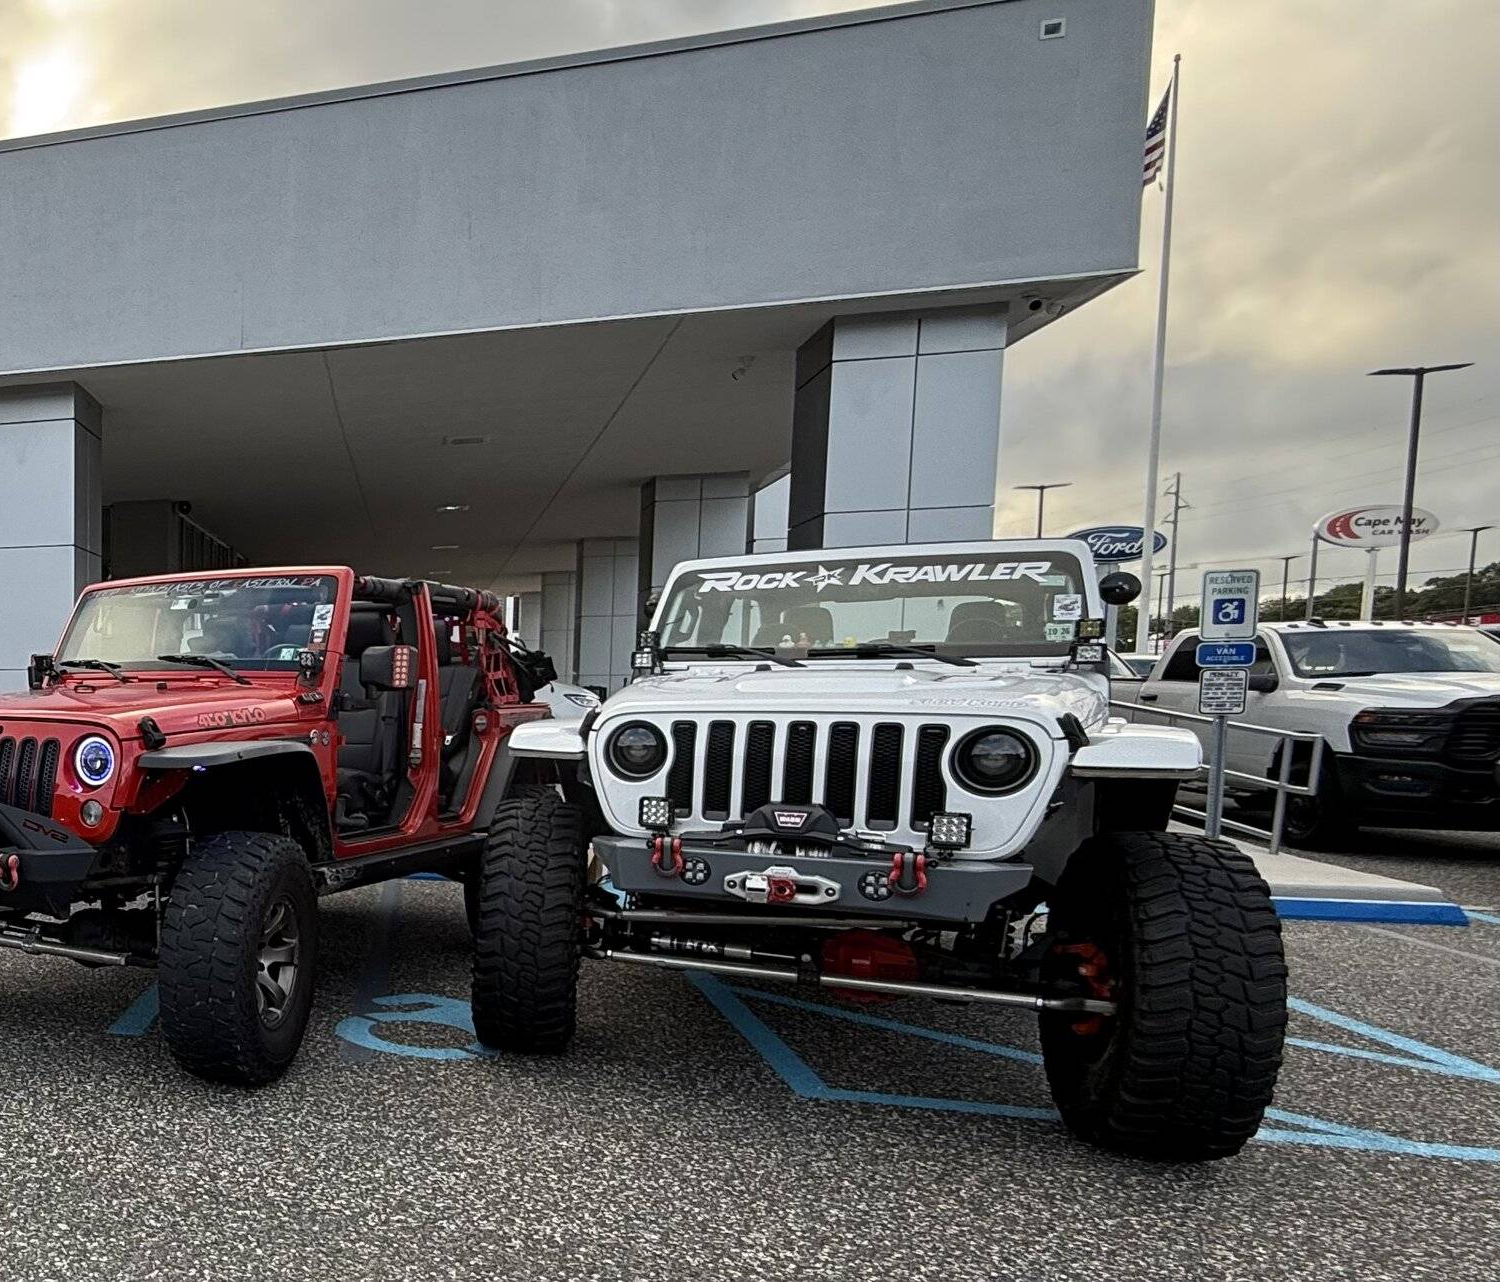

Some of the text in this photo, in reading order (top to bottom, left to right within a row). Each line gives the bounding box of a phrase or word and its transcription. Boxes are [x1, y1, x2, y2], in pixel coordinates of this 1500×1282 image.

[1355, 516, 1427, 528] Cape May
[1087, 532, 1145, 555] Ford
[236, 577, 299, 588] ASTERN
[697, 571, 807, 593] ROCK
[848, 561, 1052, 586] KRAWLER
[1209, 575, 1254, 584] RESERVED
[1211, 587, 1250, 595] PARKING
